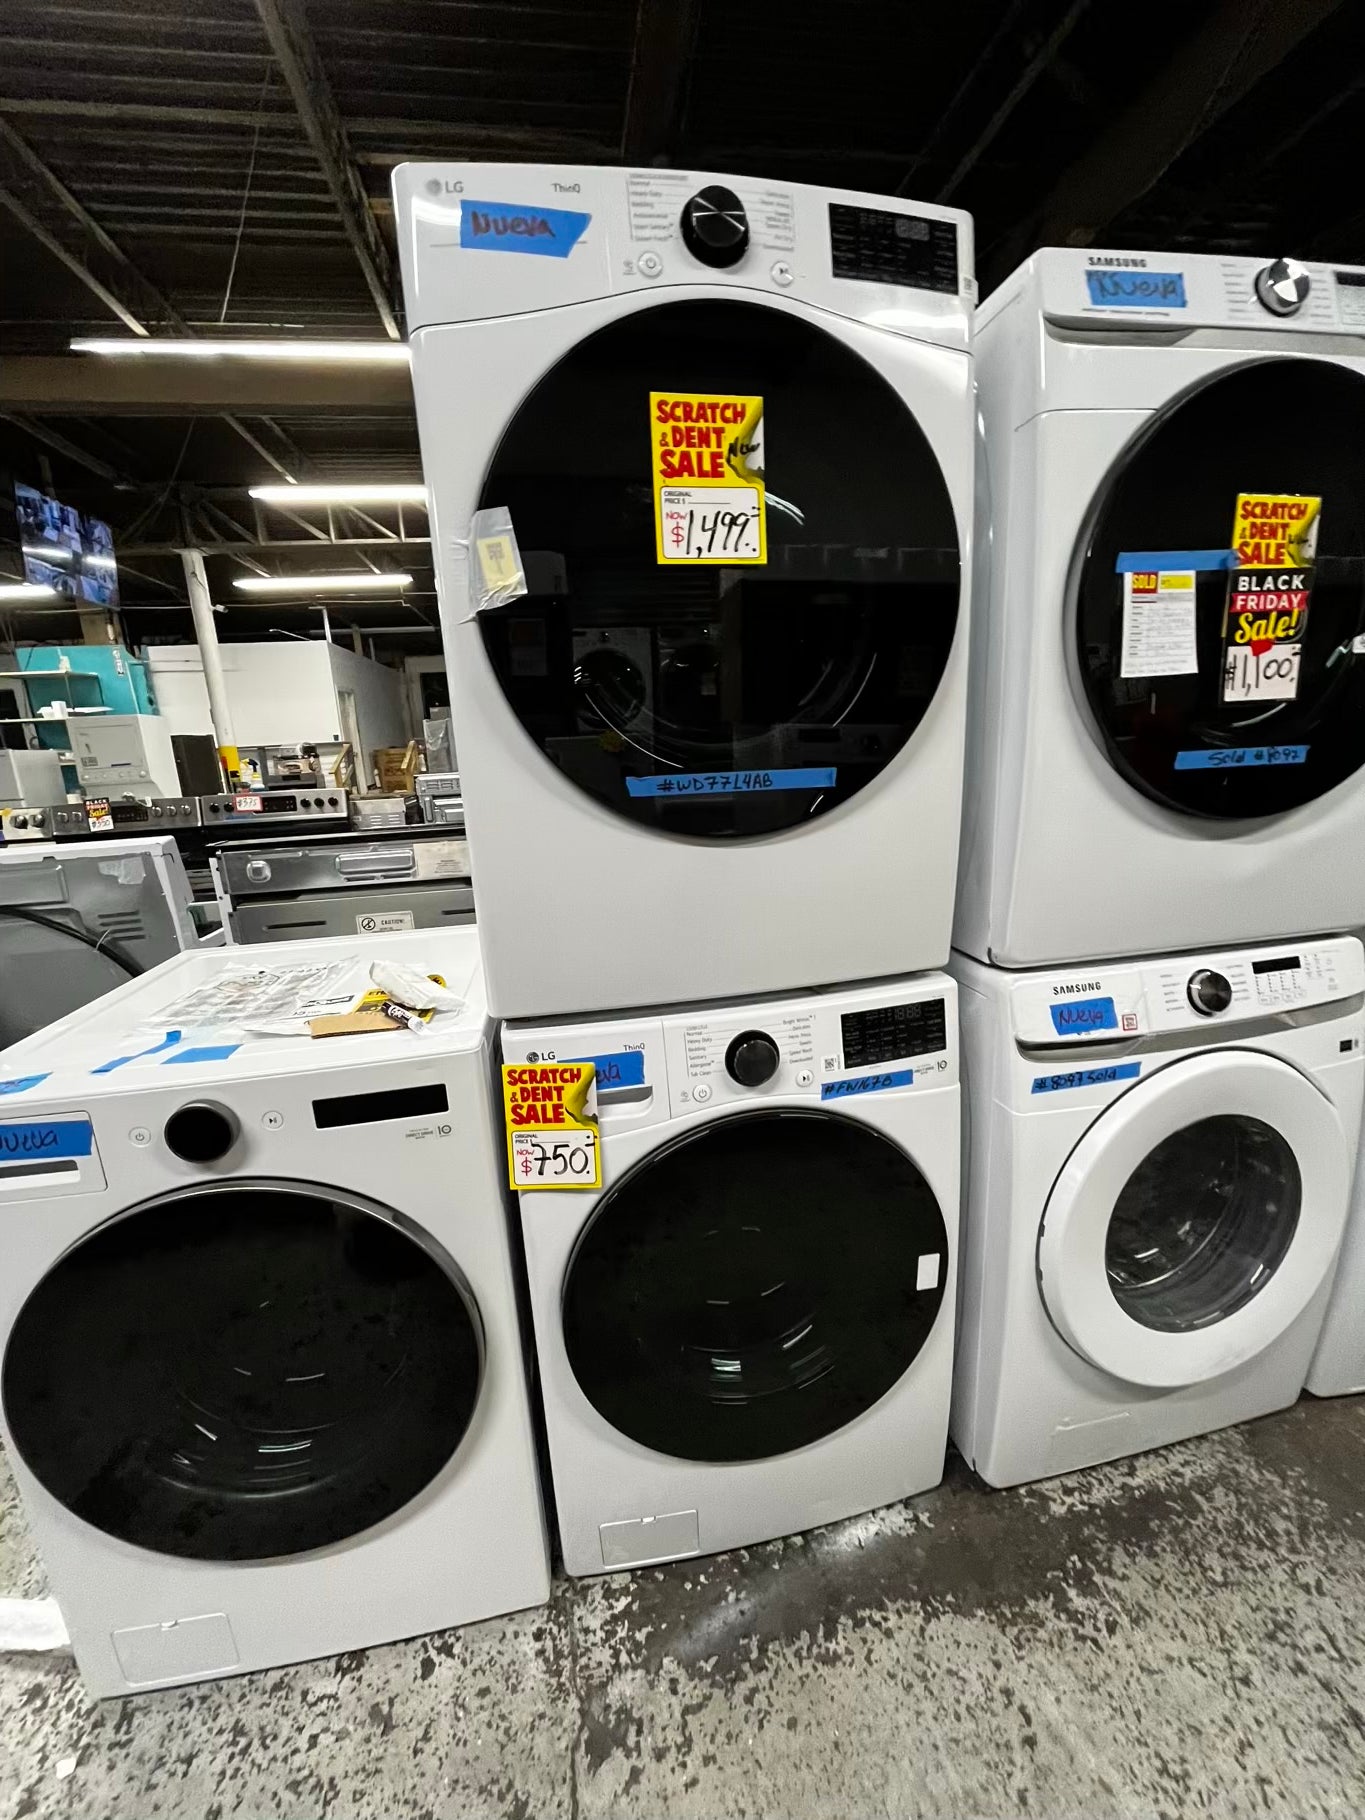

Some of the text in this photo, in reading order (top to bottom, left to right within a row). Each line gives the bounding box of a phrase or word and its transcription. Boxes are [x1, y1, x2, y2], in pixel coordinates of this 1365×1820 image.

[445, 181, 464, 193] LG
[1088, 256, 1147, 268] SAMSUNG
[656, 399, 747, 424] SCRATCH
[659, 425, 726, 449] & DENT
[659, 449, 726, 479] SALE
[665, 512, 688, 520] NOW
[1239, 501, 1309, 520] SCRATCH
[1249, 521, 1290, 541] DENT
[1238, 541, 1286, 565] SALE
[1237, 574, 1306, 592] BLACK
[1236, 594, 1301, 612] FRIDAY
[1234, 607, 1299, 644] Sale!
[1052, 981, 1102, 996] SAMSUNG
[623, 1042, 646, 1051] ThinQ
[541, 1051, 556, 1061] LG
[506, 1067, 582, 1086] SCRATCH
[509, 1085, 565, 1103] & DENT
[510, 1103, 566, 1125] SALE
